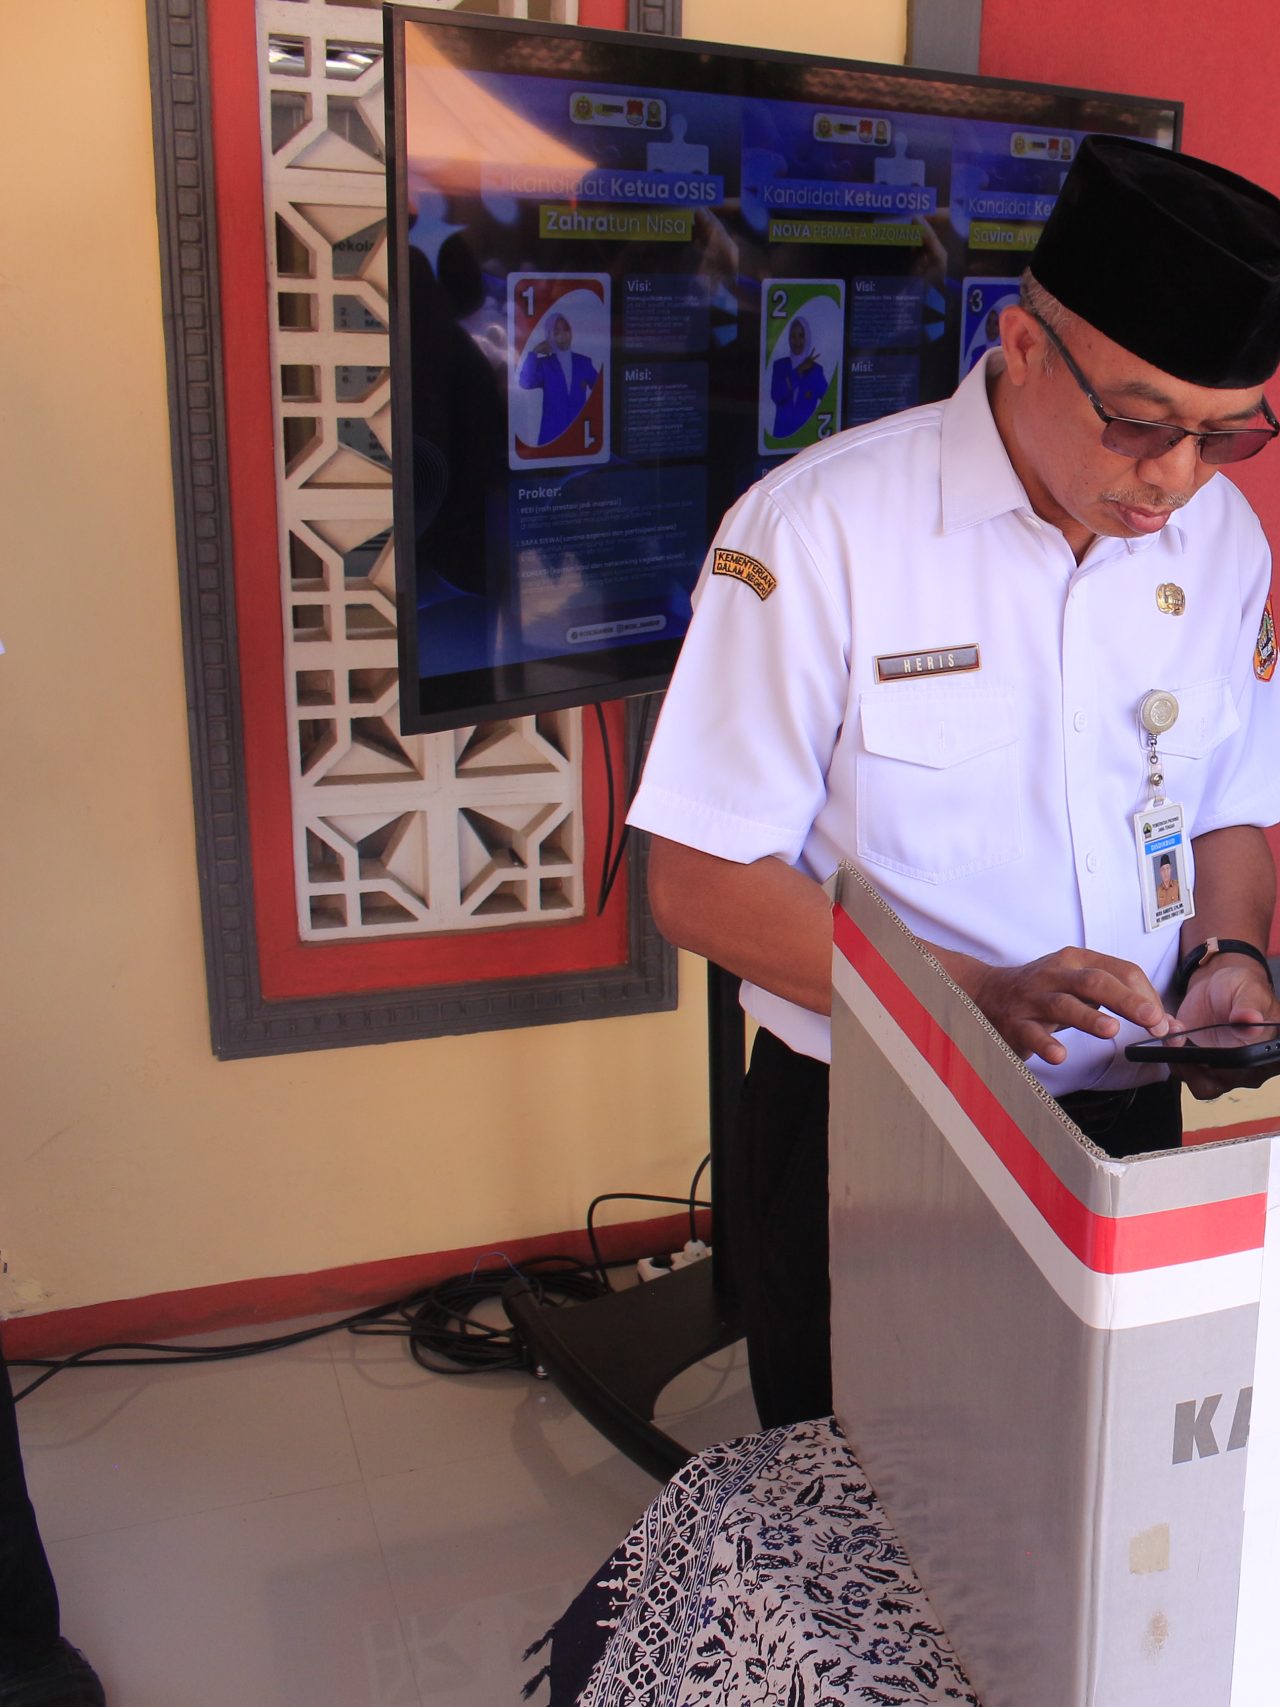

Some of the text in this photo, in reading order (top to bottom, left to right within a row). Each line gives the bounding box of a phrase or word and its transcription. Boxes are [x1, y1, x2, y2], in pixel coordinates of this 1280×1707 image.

[511, 174, 717, 200] Kandidat Ketua OSIS
[763, 184, 930, 210] Kandidat Ketua OSIS
[968, 197, 1031, 216] Kandidat
[547, 211, 686, 234] Zahratun Nisa
[772, 224, 811, 238] NOVA
[813, 226, 866, 240] PERMATA
[973, 228, 1014, 243] Savira
[627, 279, 652, 292] Visi:
[856, 281, 875, 293] Visi:
[522, 286, 534, 316] 1
[772, 290, 787, 317] 2
[971, 289, 983, 312] 3
[625, 369, 652, 382] Misi:
[852, 362, 873, 373] Misi:
[518, 486, 562, 500] Proker:
[717, 563, 769, 596] DALAM NEGERI
[718, 552, 774, 589] KEMENTERIAN
[903, 653, 956, 674] HERIS
